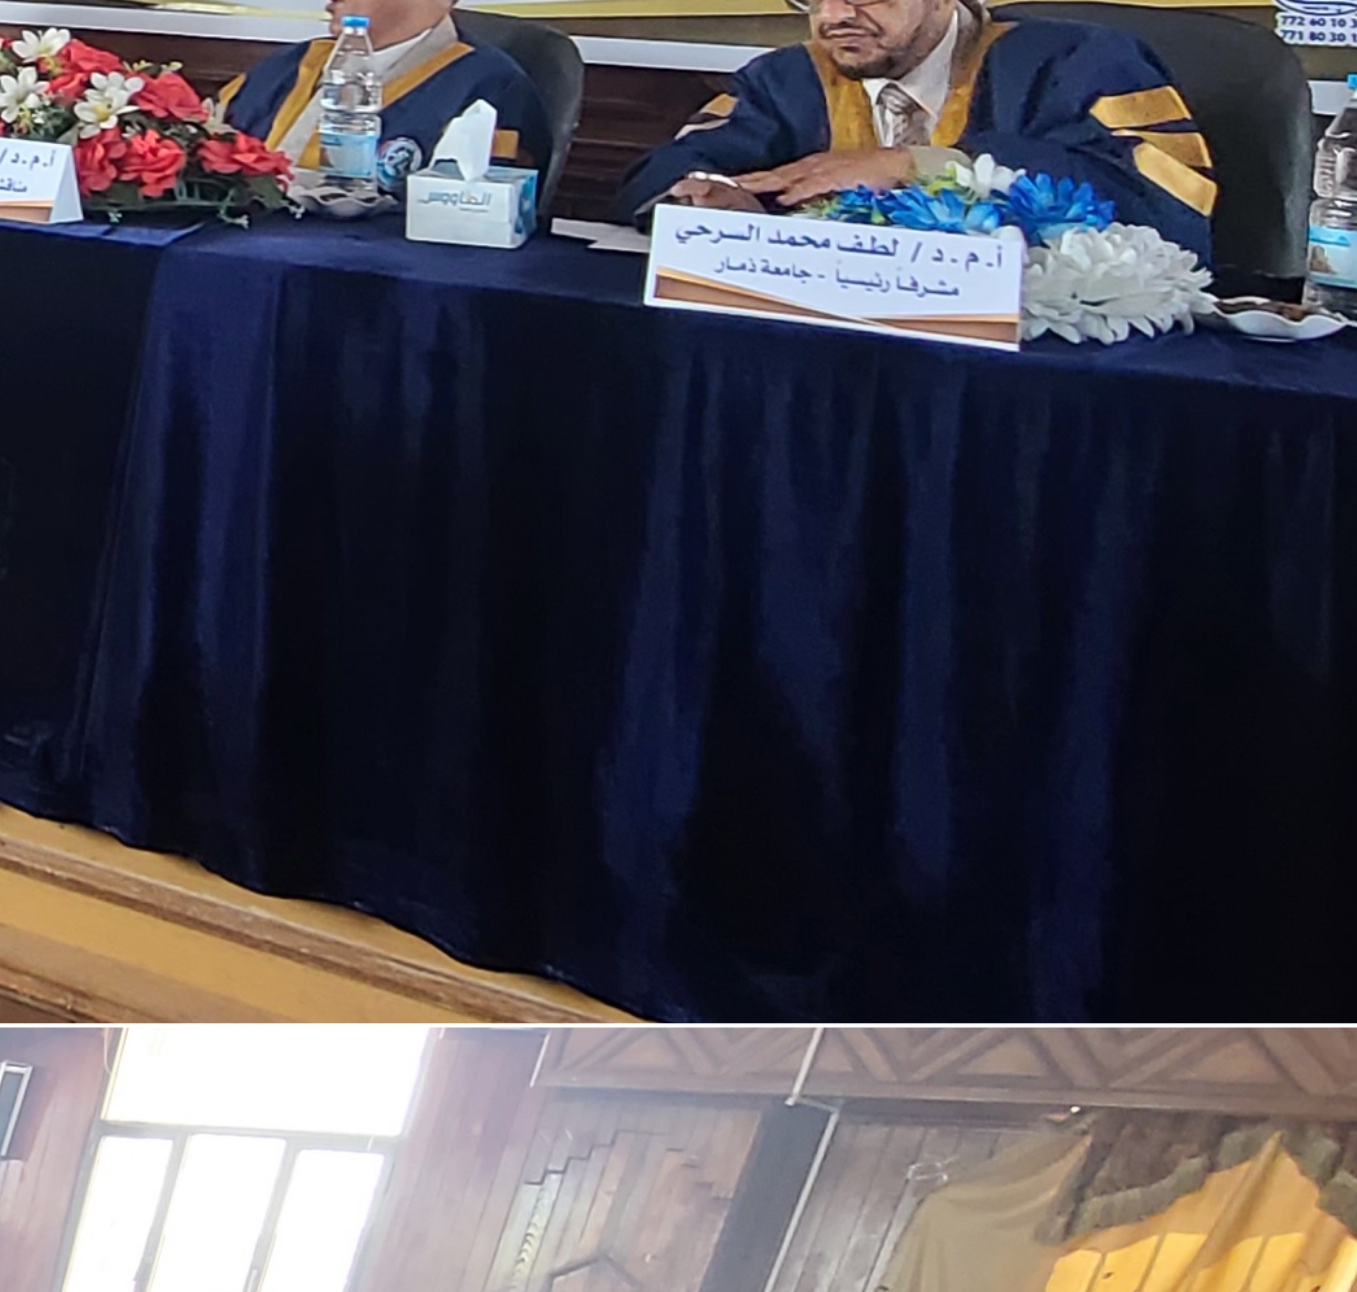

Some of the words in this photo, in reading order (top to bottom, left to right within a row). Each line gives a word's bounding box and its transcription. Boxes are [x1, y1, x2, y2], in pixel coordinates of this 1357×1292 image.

[1280, 16, 1305, 26] 772
[1280, 30, 1303, 40] 771
[675, 223, 760, 245] السرحي
[768, 229, 830, 249] محمد
[837, 233, 899, 257] لطف
[714, 257, 757, 275] ذمار
[761, 258, 812, 284] جامعة
